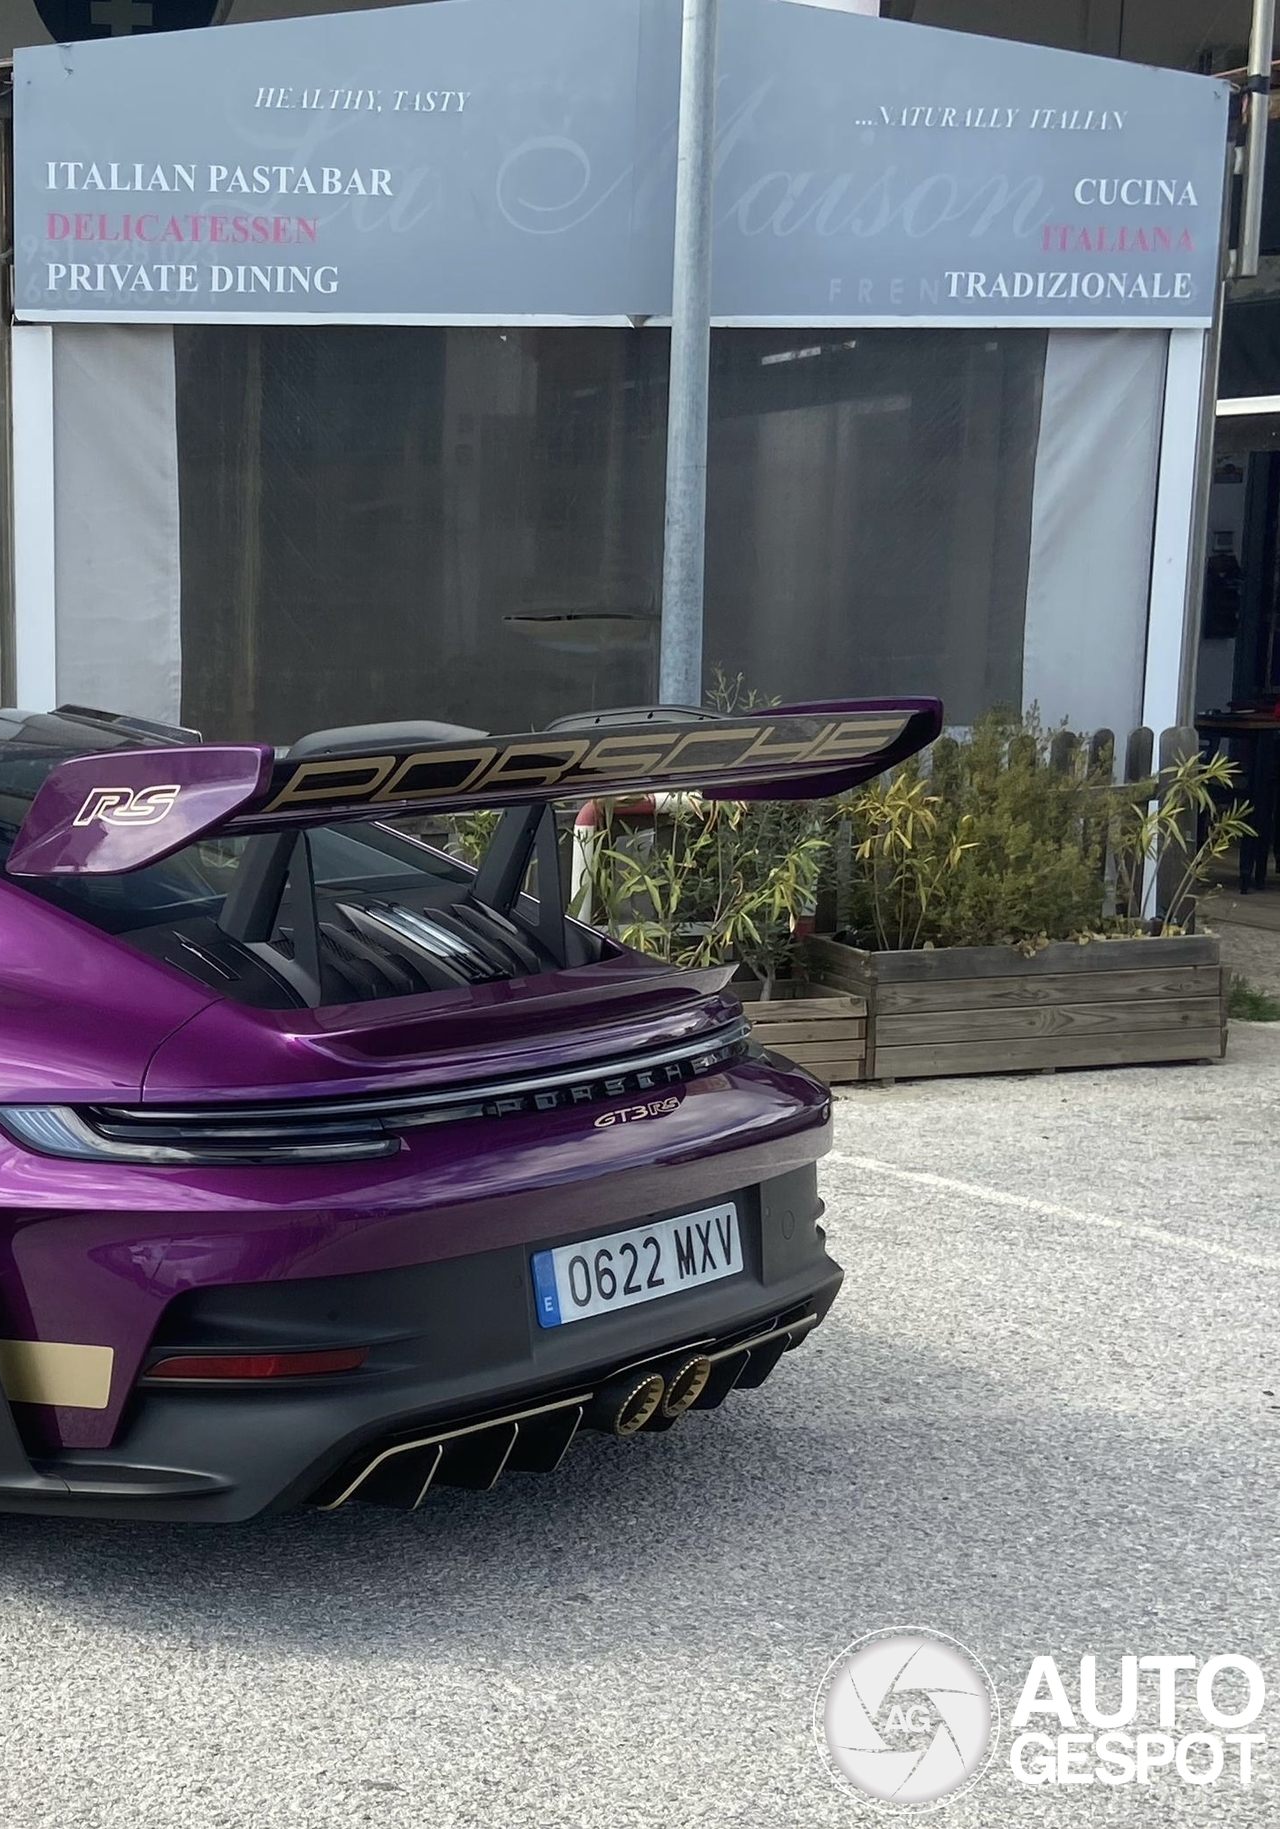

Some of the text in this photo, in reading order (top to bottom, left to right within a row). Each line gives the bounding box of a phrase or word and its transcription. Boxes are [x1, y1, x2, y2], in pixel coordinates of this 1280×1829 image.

[254, 87, 471, 113] HEALTHY, TASTY
[1029, 107, 1128, 131] ITALIAN
[46, 161, 394, 197] ITALIAN PASTABAR
[1074, 178, 1199, 208] CUCINA
[46, 212, 319, 245] DELICATESSEN
[1040, 224, 1195, 253] ITALIANA
[46, 262, 199, 292] PRIVATE
[208, 264, 340, 295] DINING
[944, 271, 1193, 299] TRADIZIONALE
[260, 718, 907, 813] PORSCHE
[72, 785, 181, 826] RS
[496, 1053, 718, 1118] PORSCHE
[568, 1214, 732, 1308] 0622 MXV
[543, 1296, 554, 1313] E
